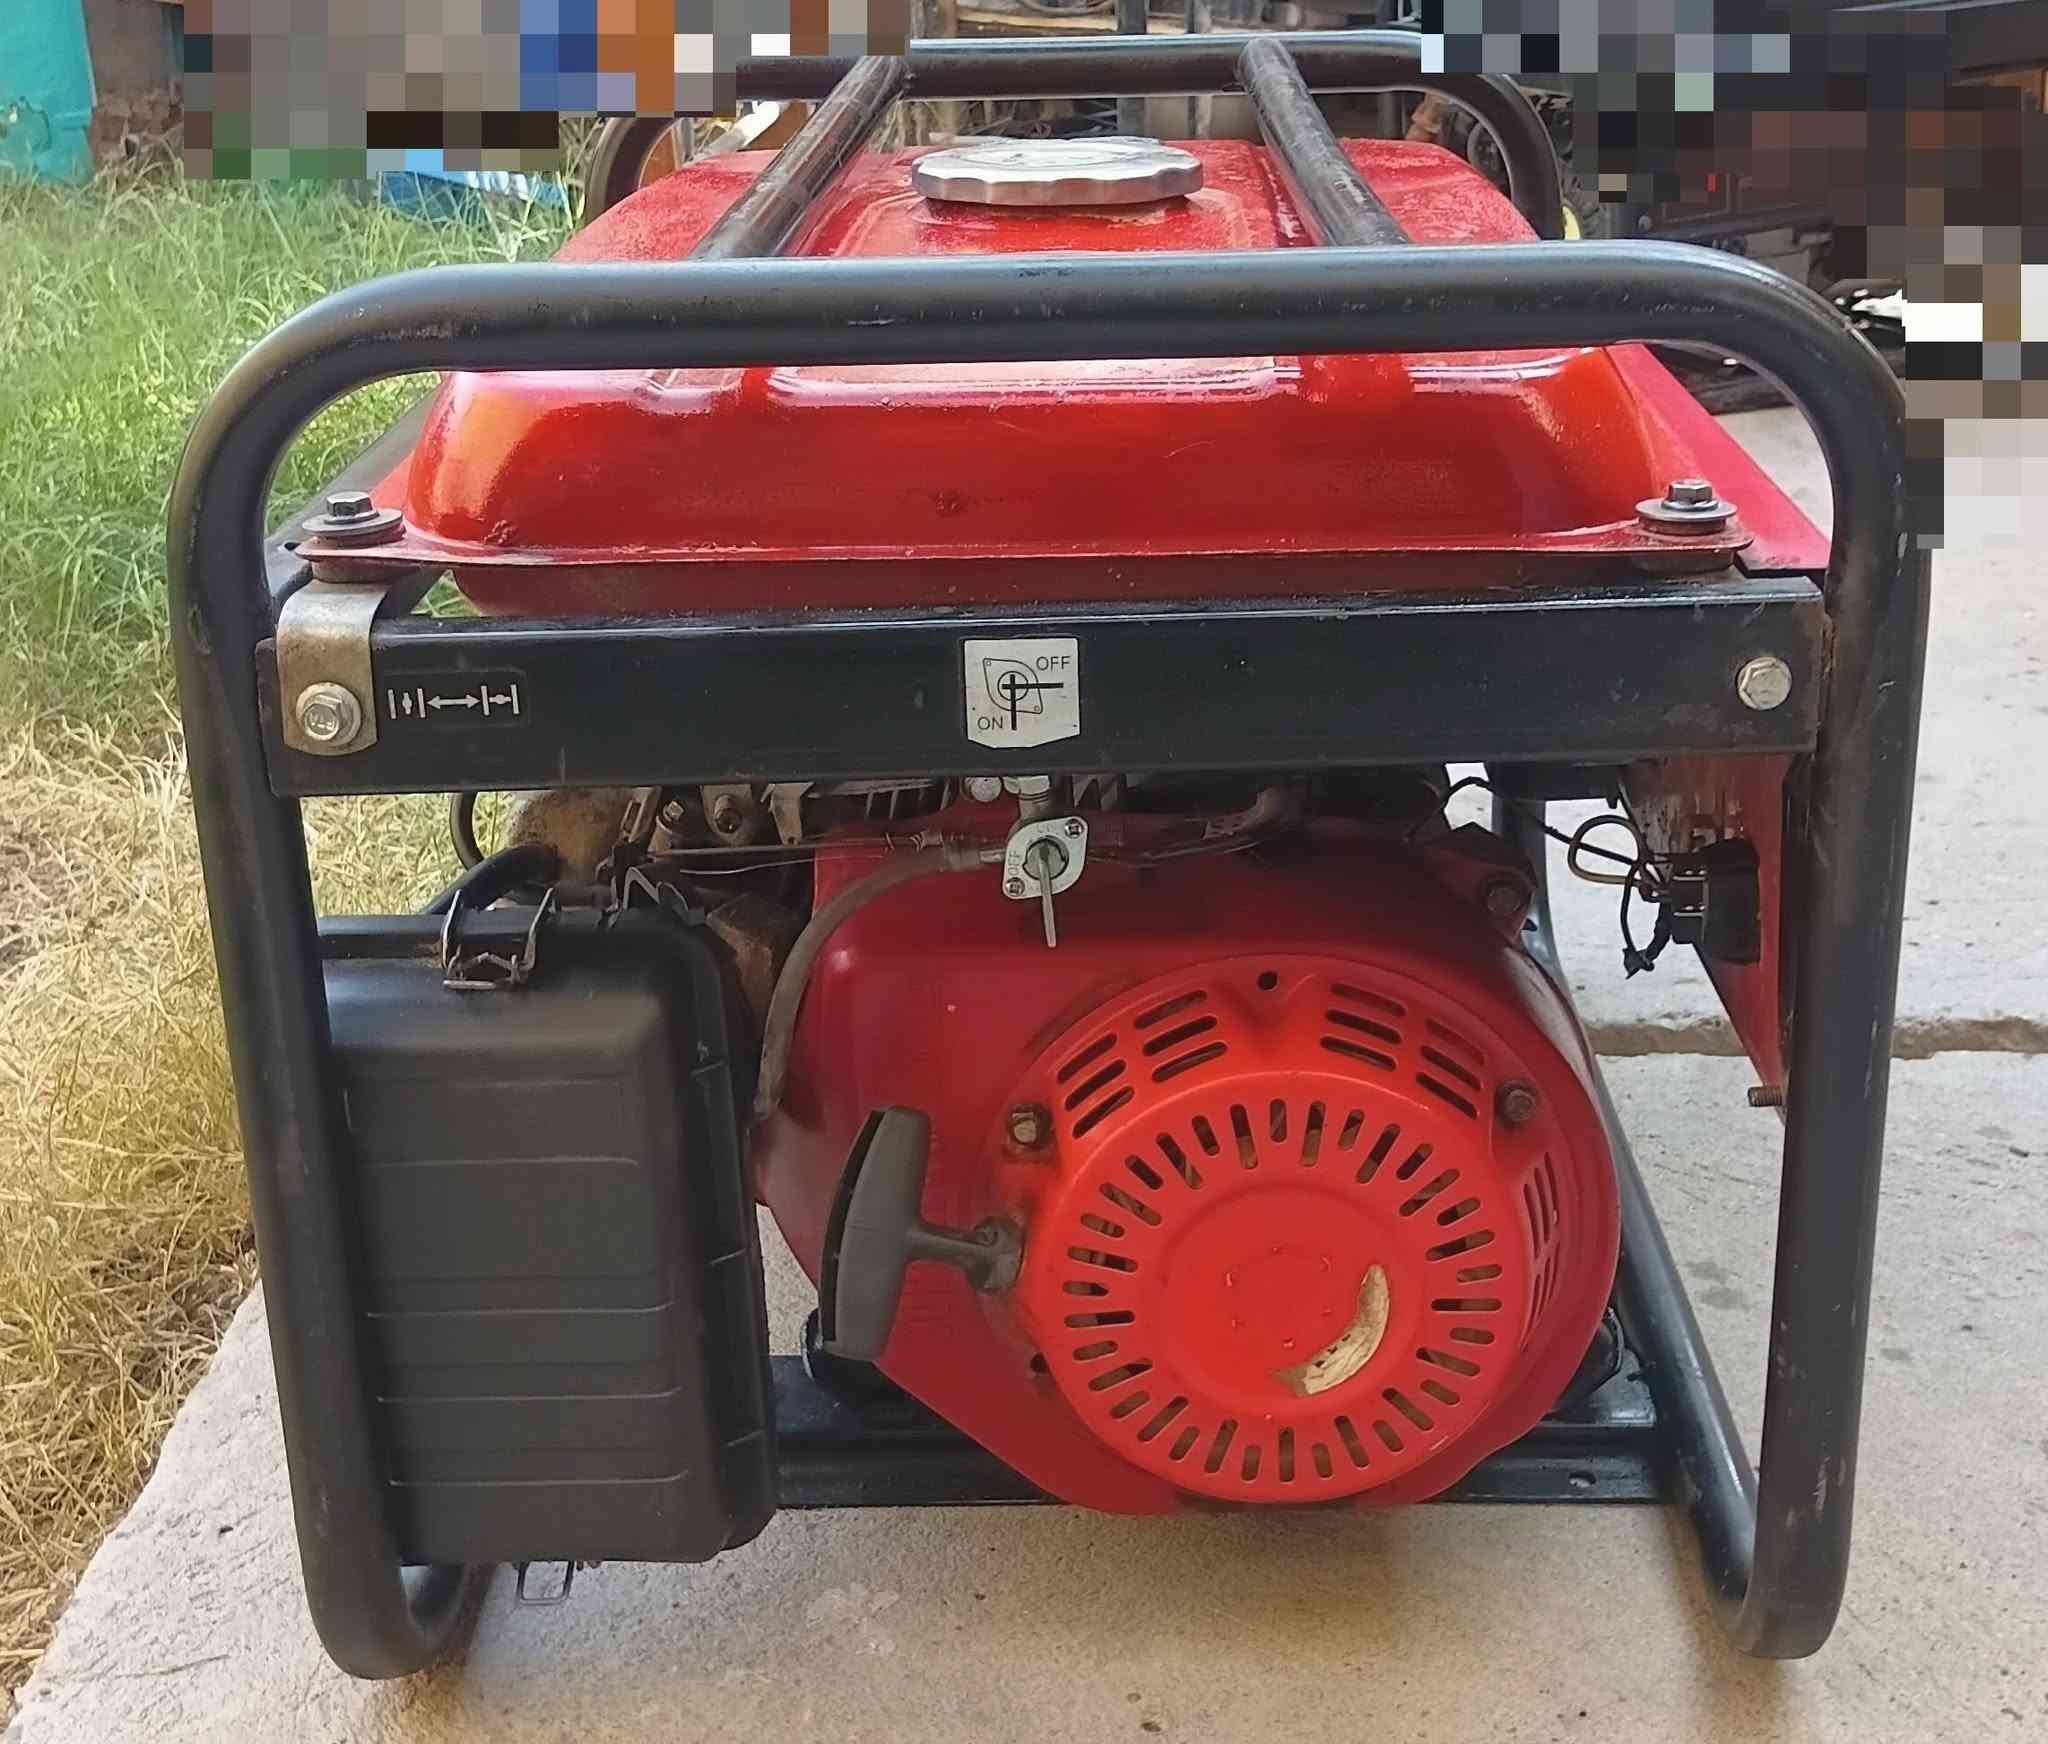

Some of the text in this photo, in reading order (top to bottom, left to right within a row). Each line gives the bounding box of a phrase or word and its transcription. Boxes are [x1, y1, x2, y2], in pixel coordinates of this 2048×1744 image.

[1036, 655, 1071, 671] OFF
[977, 716, 1004, 730] ON
[1007, 849, 1021, 876] OFF
